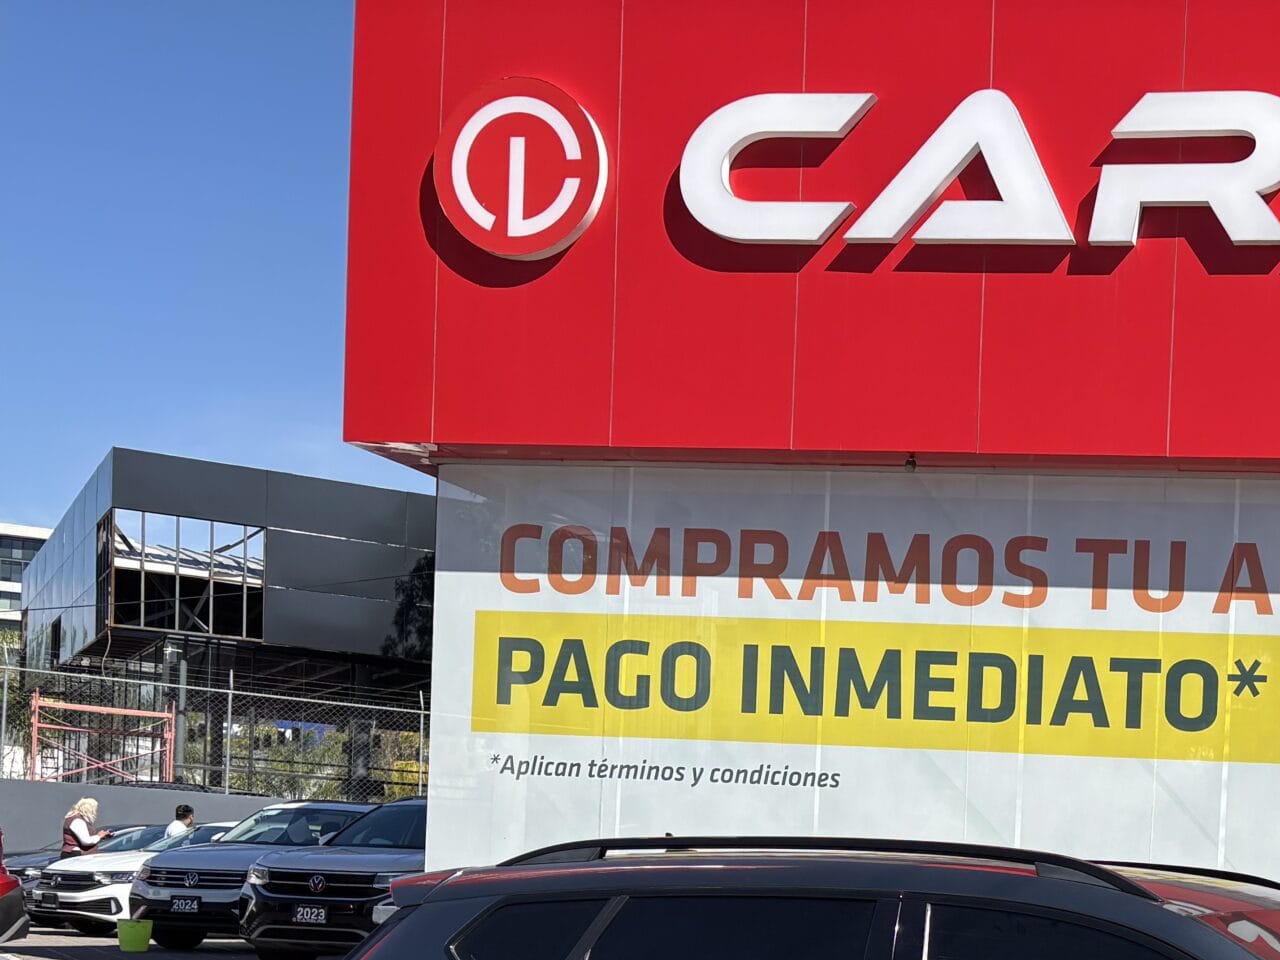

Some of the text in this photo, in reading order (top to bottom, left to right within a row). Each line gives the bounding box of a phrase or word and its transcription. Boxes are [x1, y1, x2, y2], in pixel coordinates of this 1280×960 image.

[500, 524, 1048, 608] COMPRAMOS
[1075, 538, 1187, 613] TU
[496, 637, 711, 712] PAGO
[587, 759, 685, 783] términos
[691, 768, 705, 787] y
[709, 765, 841, 789] condiciones
[172, 899, 198, 910] 2024
[297, 907, 325, 920] 2023
